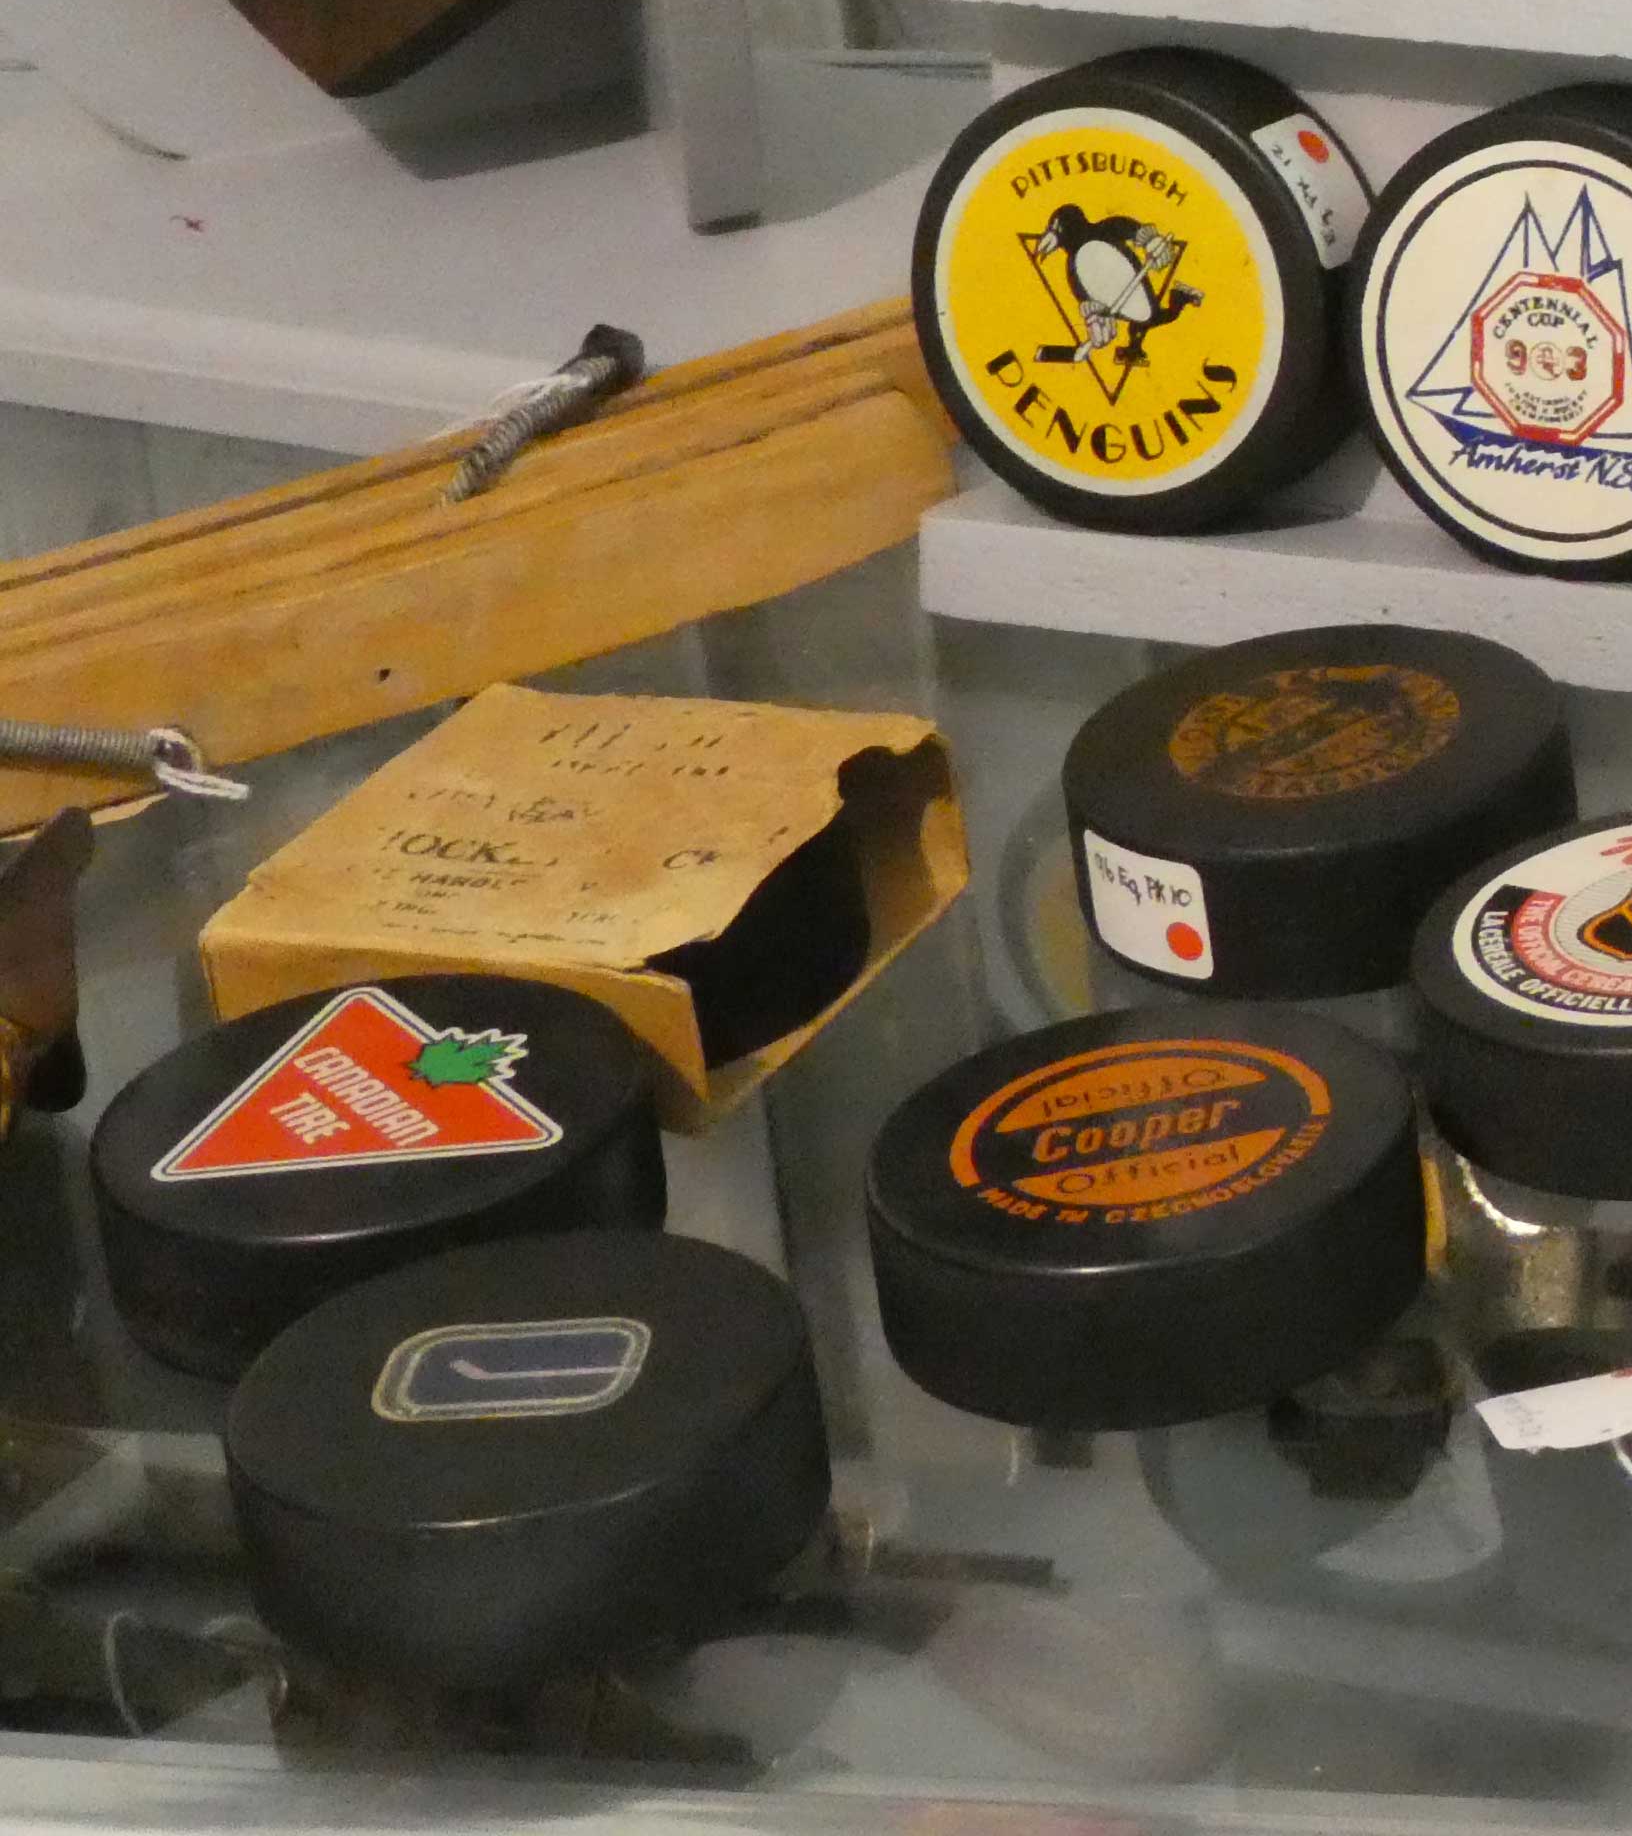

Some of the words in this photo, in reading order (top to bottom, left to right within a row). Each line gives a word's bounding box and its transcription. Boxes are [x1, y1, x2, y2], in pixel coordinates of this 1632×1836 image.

[1010, 150, 1188, 207] PITTSBURGH
[1493, 297, 1598, 349] CENTENNIAL
[1527, 313, 1564, 327] CUP
[986, 349, 1238, 464] PENGUINS
[1449, 440, 1580, 480] Amherst
[270, 1092, 352, 1146] TIRE
[294, 1046, 441, 1148] CANADIAN
[1032, 1099, 1242, 1163] Cooper
[977, 1186, 1050, 1221] MADE
